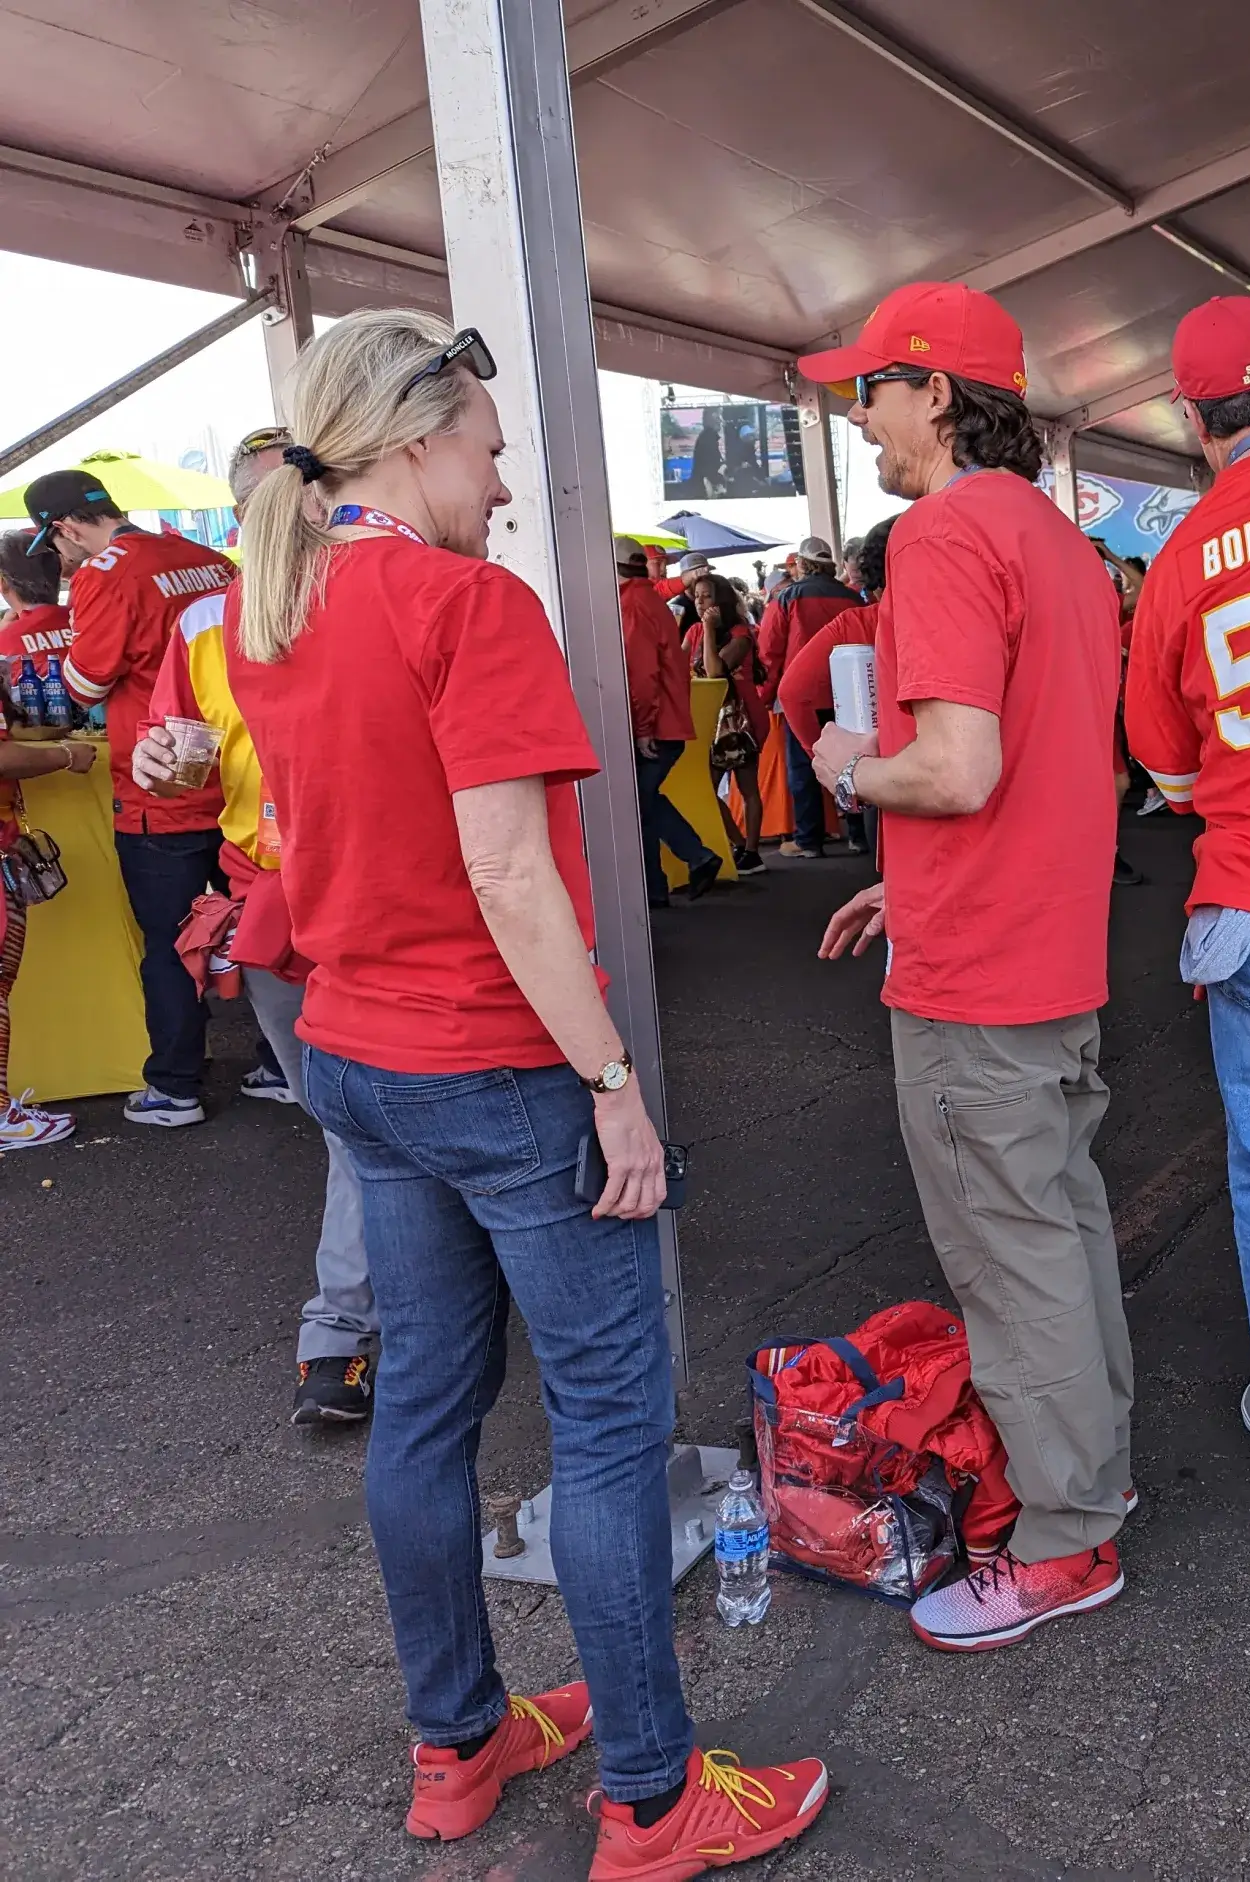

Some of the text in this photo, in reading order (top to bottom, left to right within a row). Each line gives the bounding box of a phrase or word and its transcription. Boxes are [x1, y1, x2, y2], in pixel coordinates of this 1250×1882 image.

[446, 335, 474, 360] MONCLER
[152, 564, 232, 598] MAHOMES
[865, 662, 876, 698] STELLA
